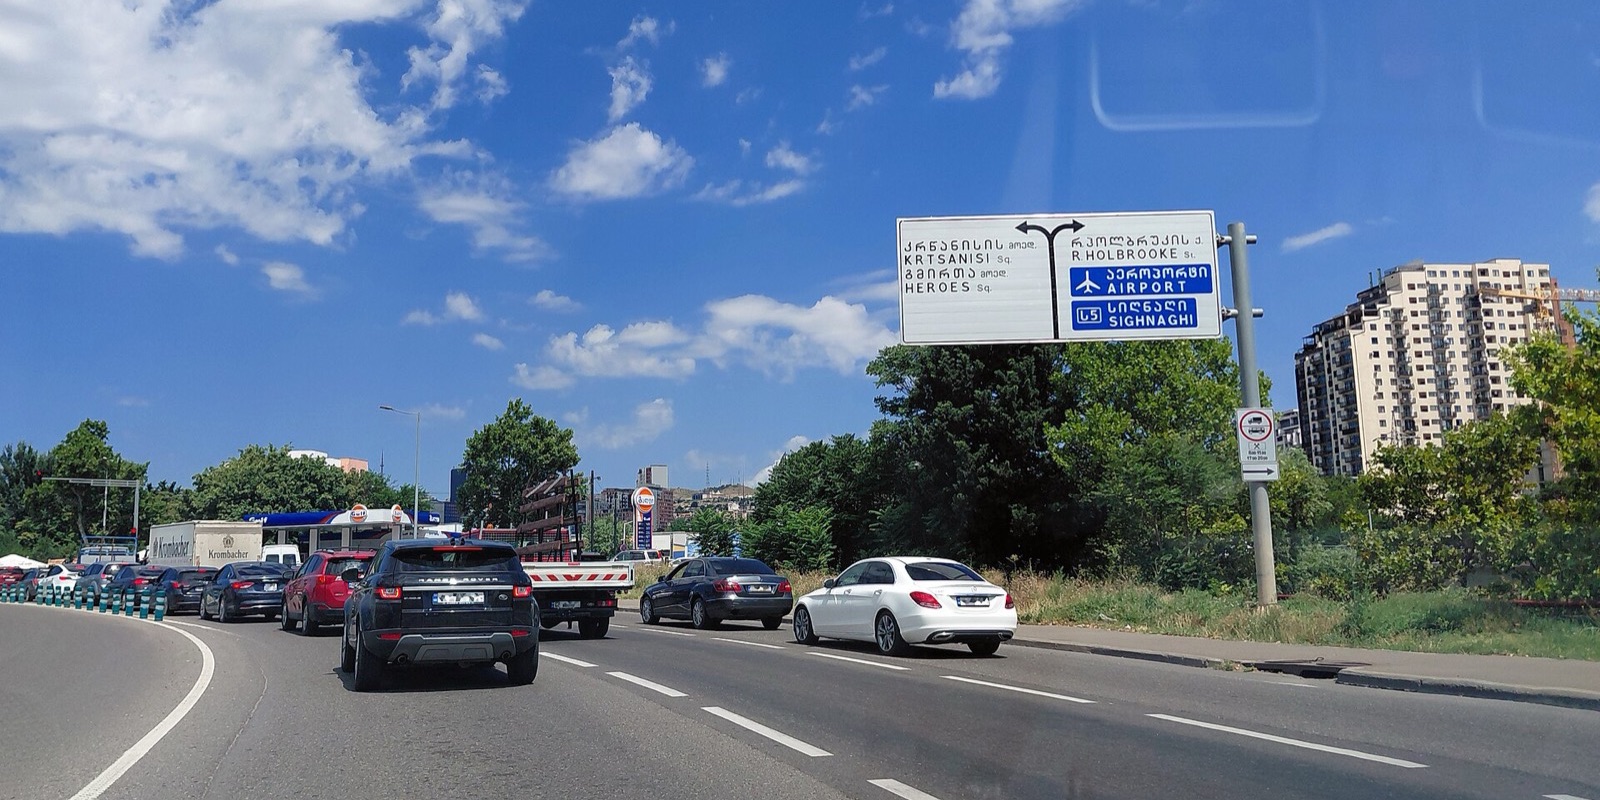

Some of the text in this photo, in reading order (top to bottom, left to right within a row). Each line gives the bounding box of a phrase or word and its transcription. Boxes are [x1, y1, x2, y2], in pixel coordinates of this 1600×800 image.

[904, 253, 1012, 266] KRTSANISI Sq.
[905, 268, 976, 280] გმირთა
[1106, 266, 1208, 280] აეროპორტი
[905, 282, 992, 294] HEROES Sq.
[1108, 281, 1186, 294] AIRPORT
[1108, 300, 1187, 313] სიღნაღი
[1109, 314, 1193, 327] SIGHNAGHI
[158, 535, 190, 558] Krombacher
[208, 549, 248, 559] Krombacher
